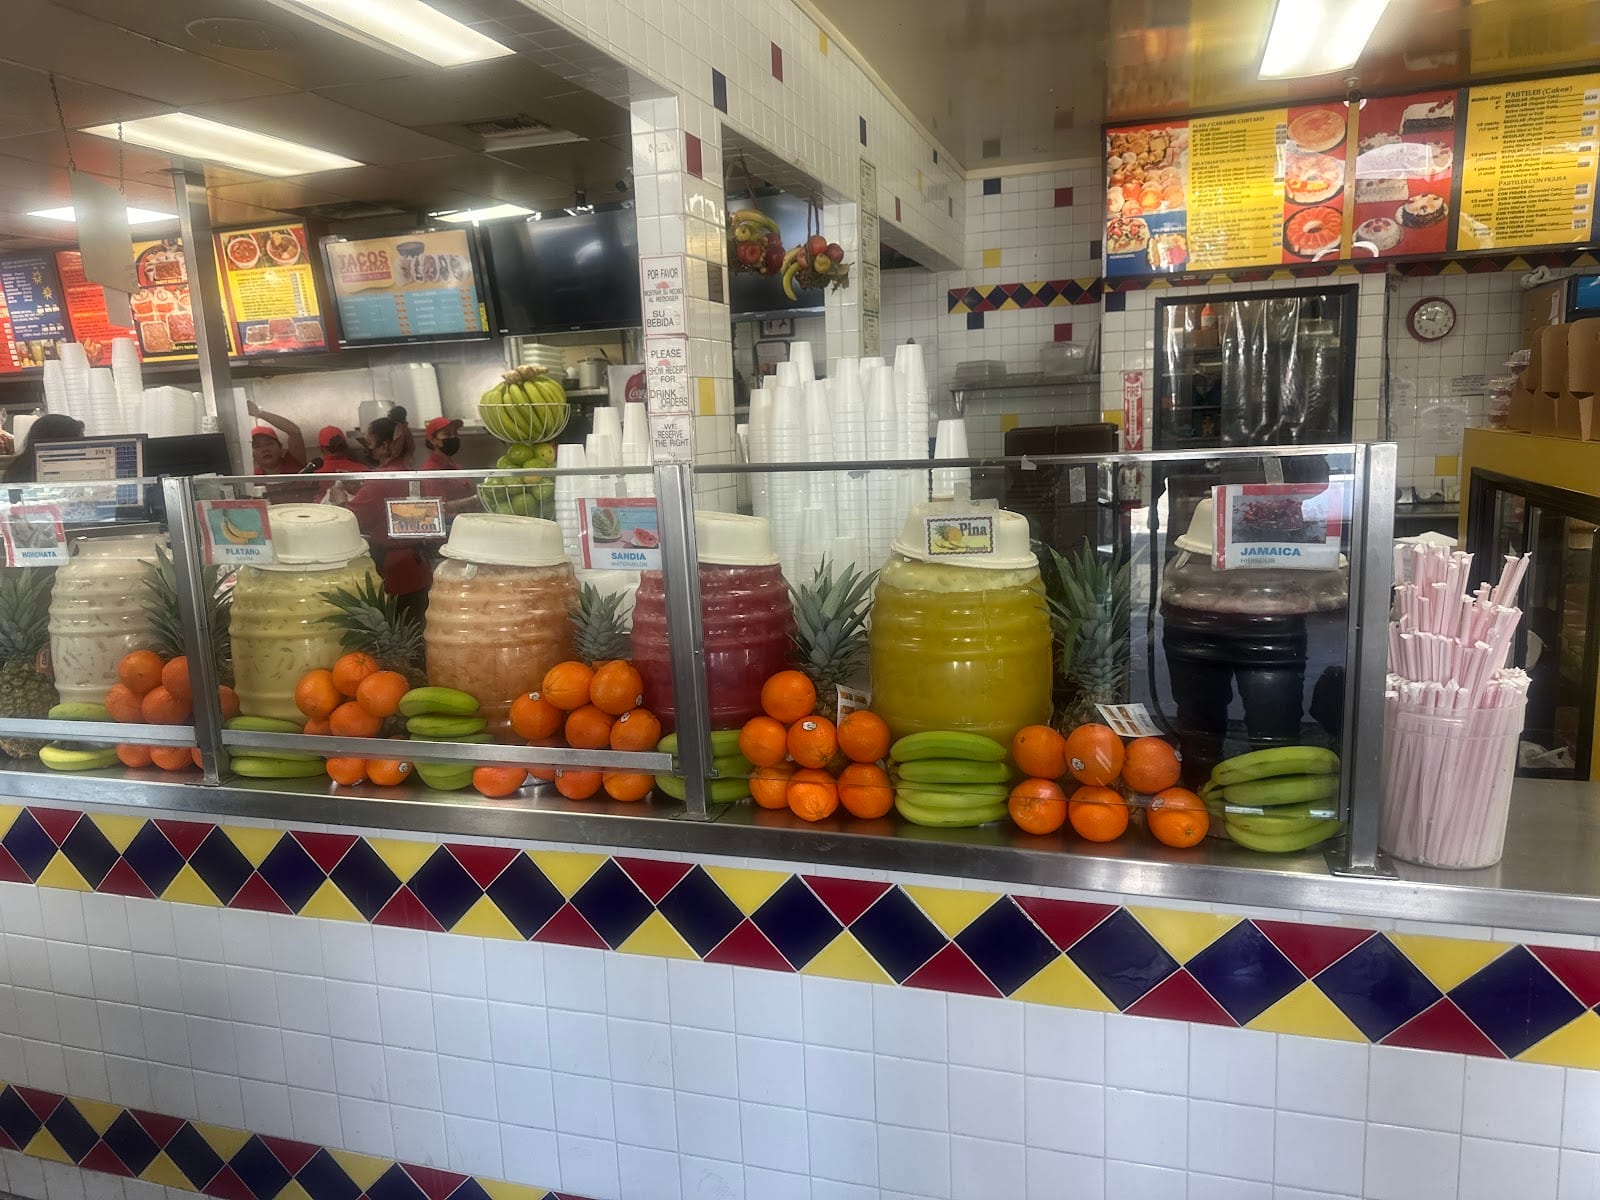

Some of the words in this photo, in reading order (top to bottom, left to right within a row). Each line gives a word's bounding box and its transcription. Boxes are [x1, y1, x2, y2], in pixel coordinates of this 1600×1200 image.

[1505, 88, 1541, 98] PASTELES
[337, 250, 389, 269] TACOS
[648, 269, 659, 279] POR
[660, 268, 678, 278] FAVOR
[652, 310, 665, 318] SU
[647, 318, 674, 327] BEBIDA
[650, 349, 682, 358] PLEASE
[660, 375, 676, 383] FOR
[650, 389, 676, 398] DRINK
[1126, 385, 1140, 397] FIRE
[660, 398, 688, 407] ORDERS
[657, 430, 682, 438] RESERVE
[226, 548, 260, 556] PLATANO
[1241, 548, 1301, 556] JAMAICA
